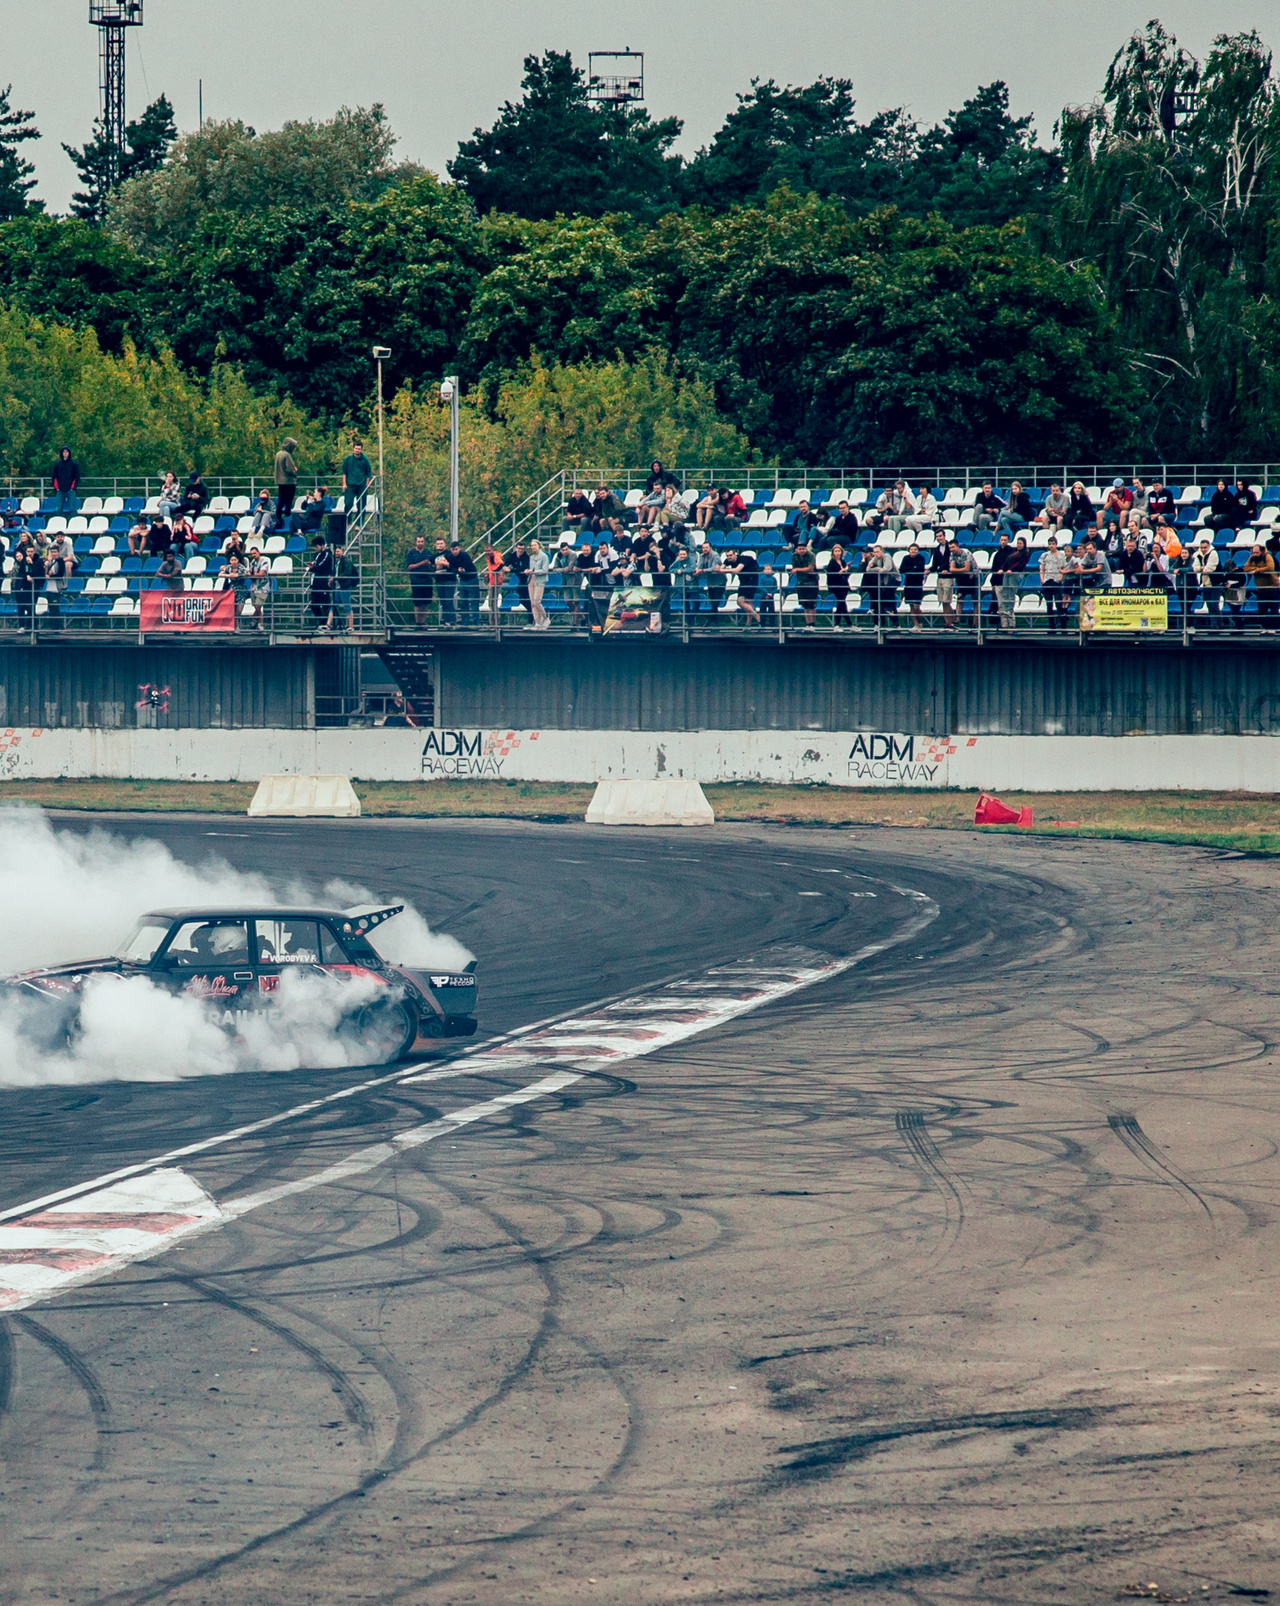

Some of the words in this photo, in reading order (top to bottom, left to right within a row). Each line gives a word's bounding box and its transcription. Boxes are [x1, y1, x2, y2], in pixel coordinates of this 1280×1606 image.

[186, 597, 213, 611] DRIFT
[186, 610, 205, 623] FUN
[422, 731, 482, 756] ADM
[849, 734, 914, 761] ADM
[422, 758, 504, 774] RACEWAY
[847, 760, 938, 781] RACEWAY
[269, 954, 310, 963] VOROBYEV
